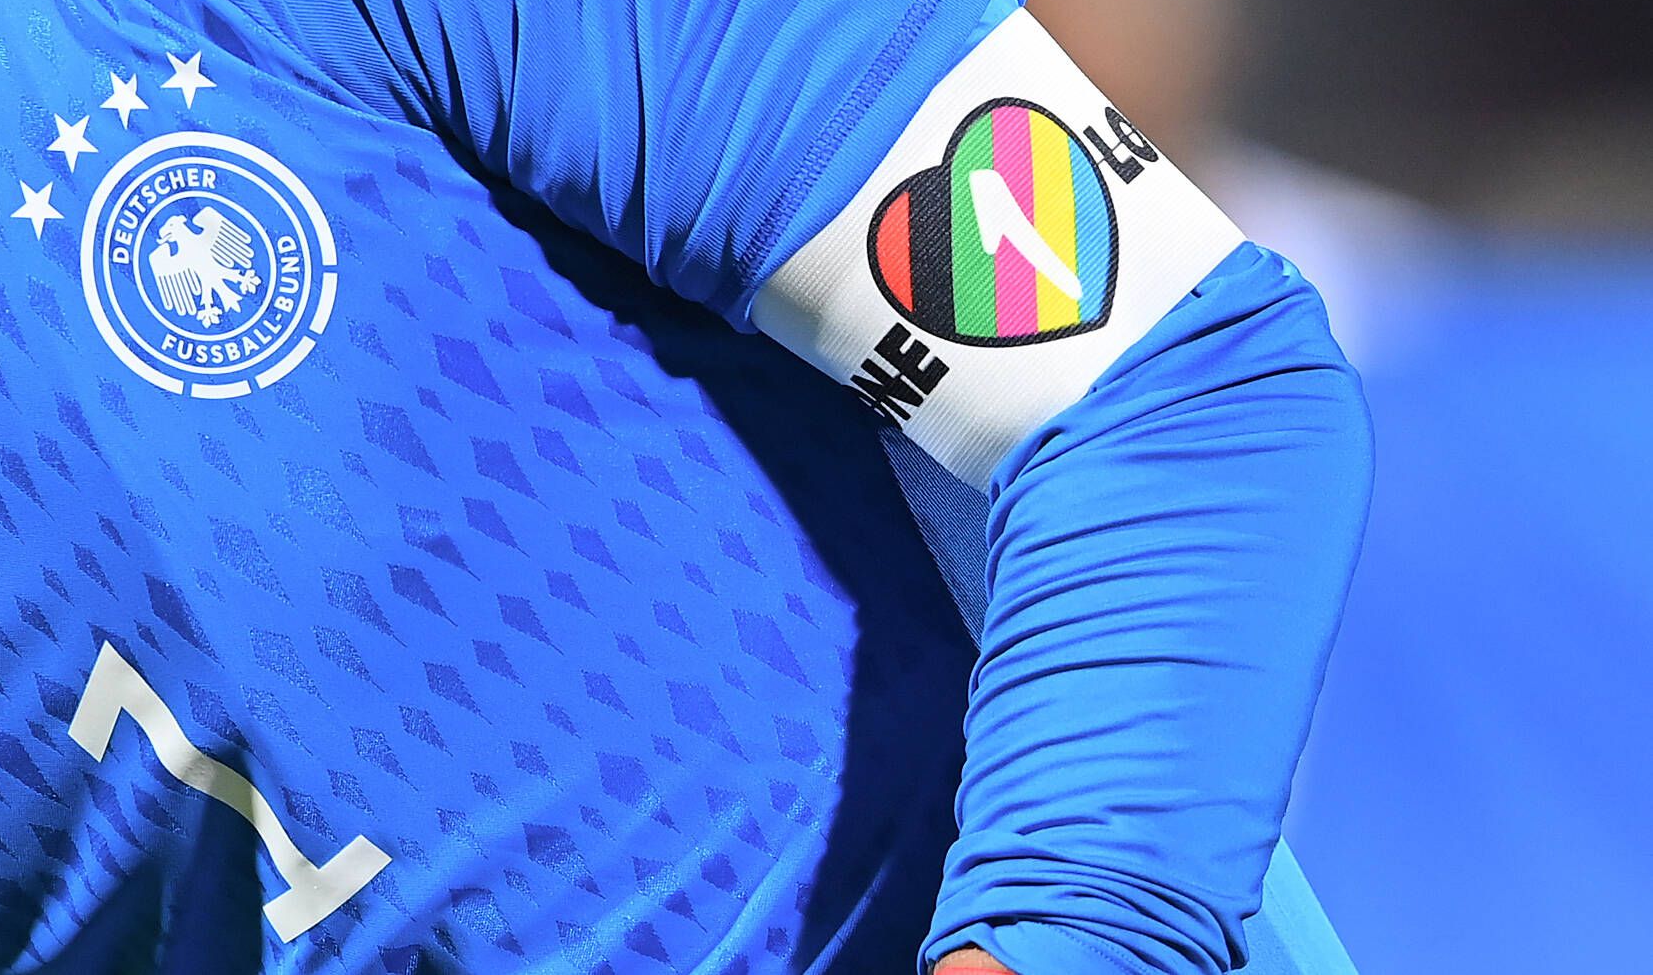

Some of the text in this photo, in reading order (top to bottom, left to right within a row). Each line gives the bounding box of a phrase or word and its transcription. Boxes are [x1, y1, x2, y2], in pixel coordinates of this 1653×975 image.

[112, 168, 217, 265] DEUTSCHER
[969, 168, 1083, 300] 1
[161, 235, 300, 364] FUSSBALL-BUND
[67, 640, 393, 943] 1
